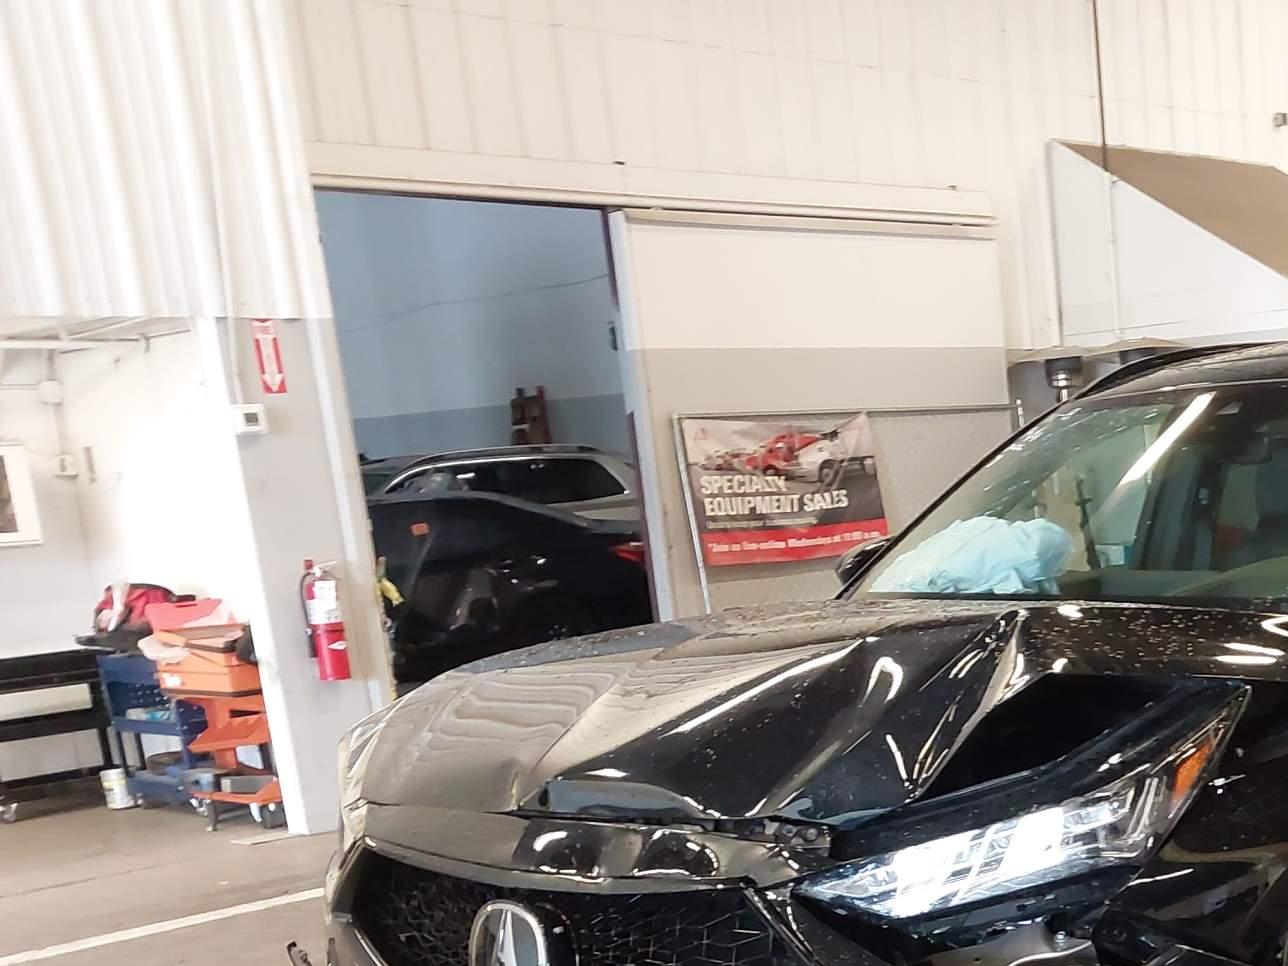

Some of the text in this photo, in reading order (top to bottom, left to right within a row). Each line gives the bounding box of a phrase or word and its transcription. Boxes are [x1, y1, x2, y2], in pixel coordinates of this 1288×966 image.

[700, 474, 787, 494] SPECIALTY
[704, 489, 849, 517] EQUIPMENT SALES
